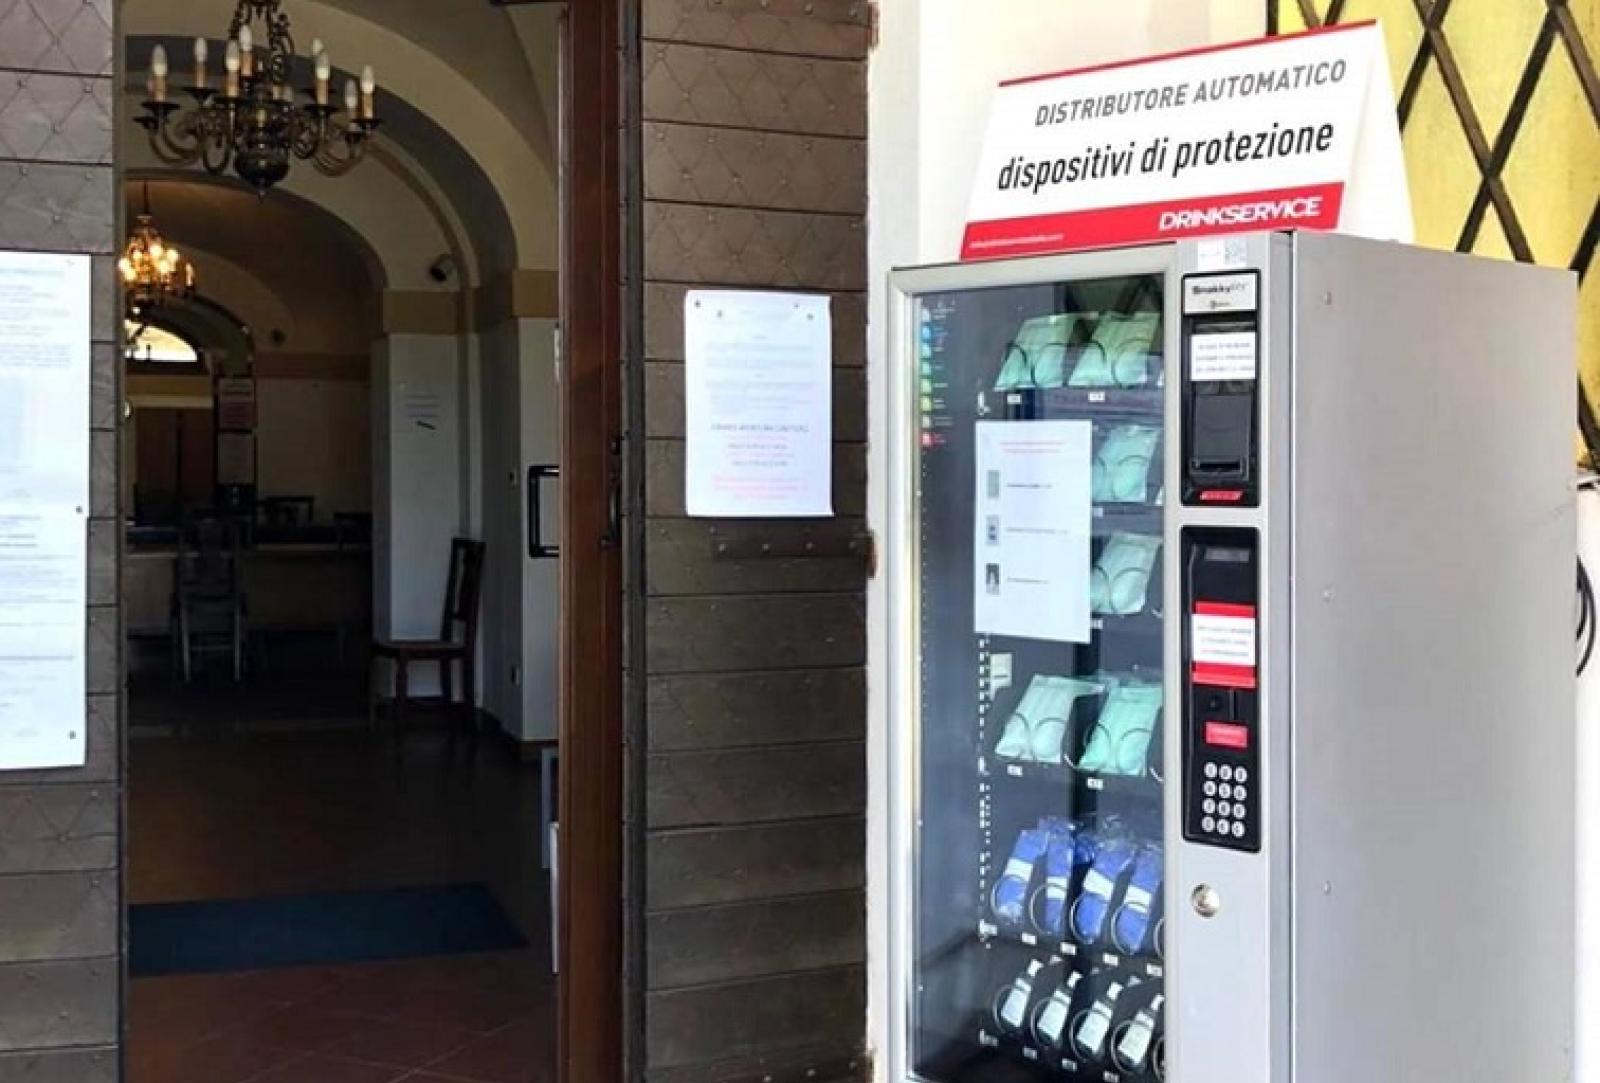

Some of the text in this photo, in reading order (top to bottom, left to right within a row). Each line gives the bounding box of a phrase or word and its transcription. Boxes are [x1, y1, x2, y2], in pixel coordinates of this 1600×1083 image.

[1036, 59, 1346, 126] DISTRIBUTORE AUTOMATICO
[998, 123, 1334, 194] dispositivi di protezione
[1159, 197, 1321, 230] DRINKSERVICE
